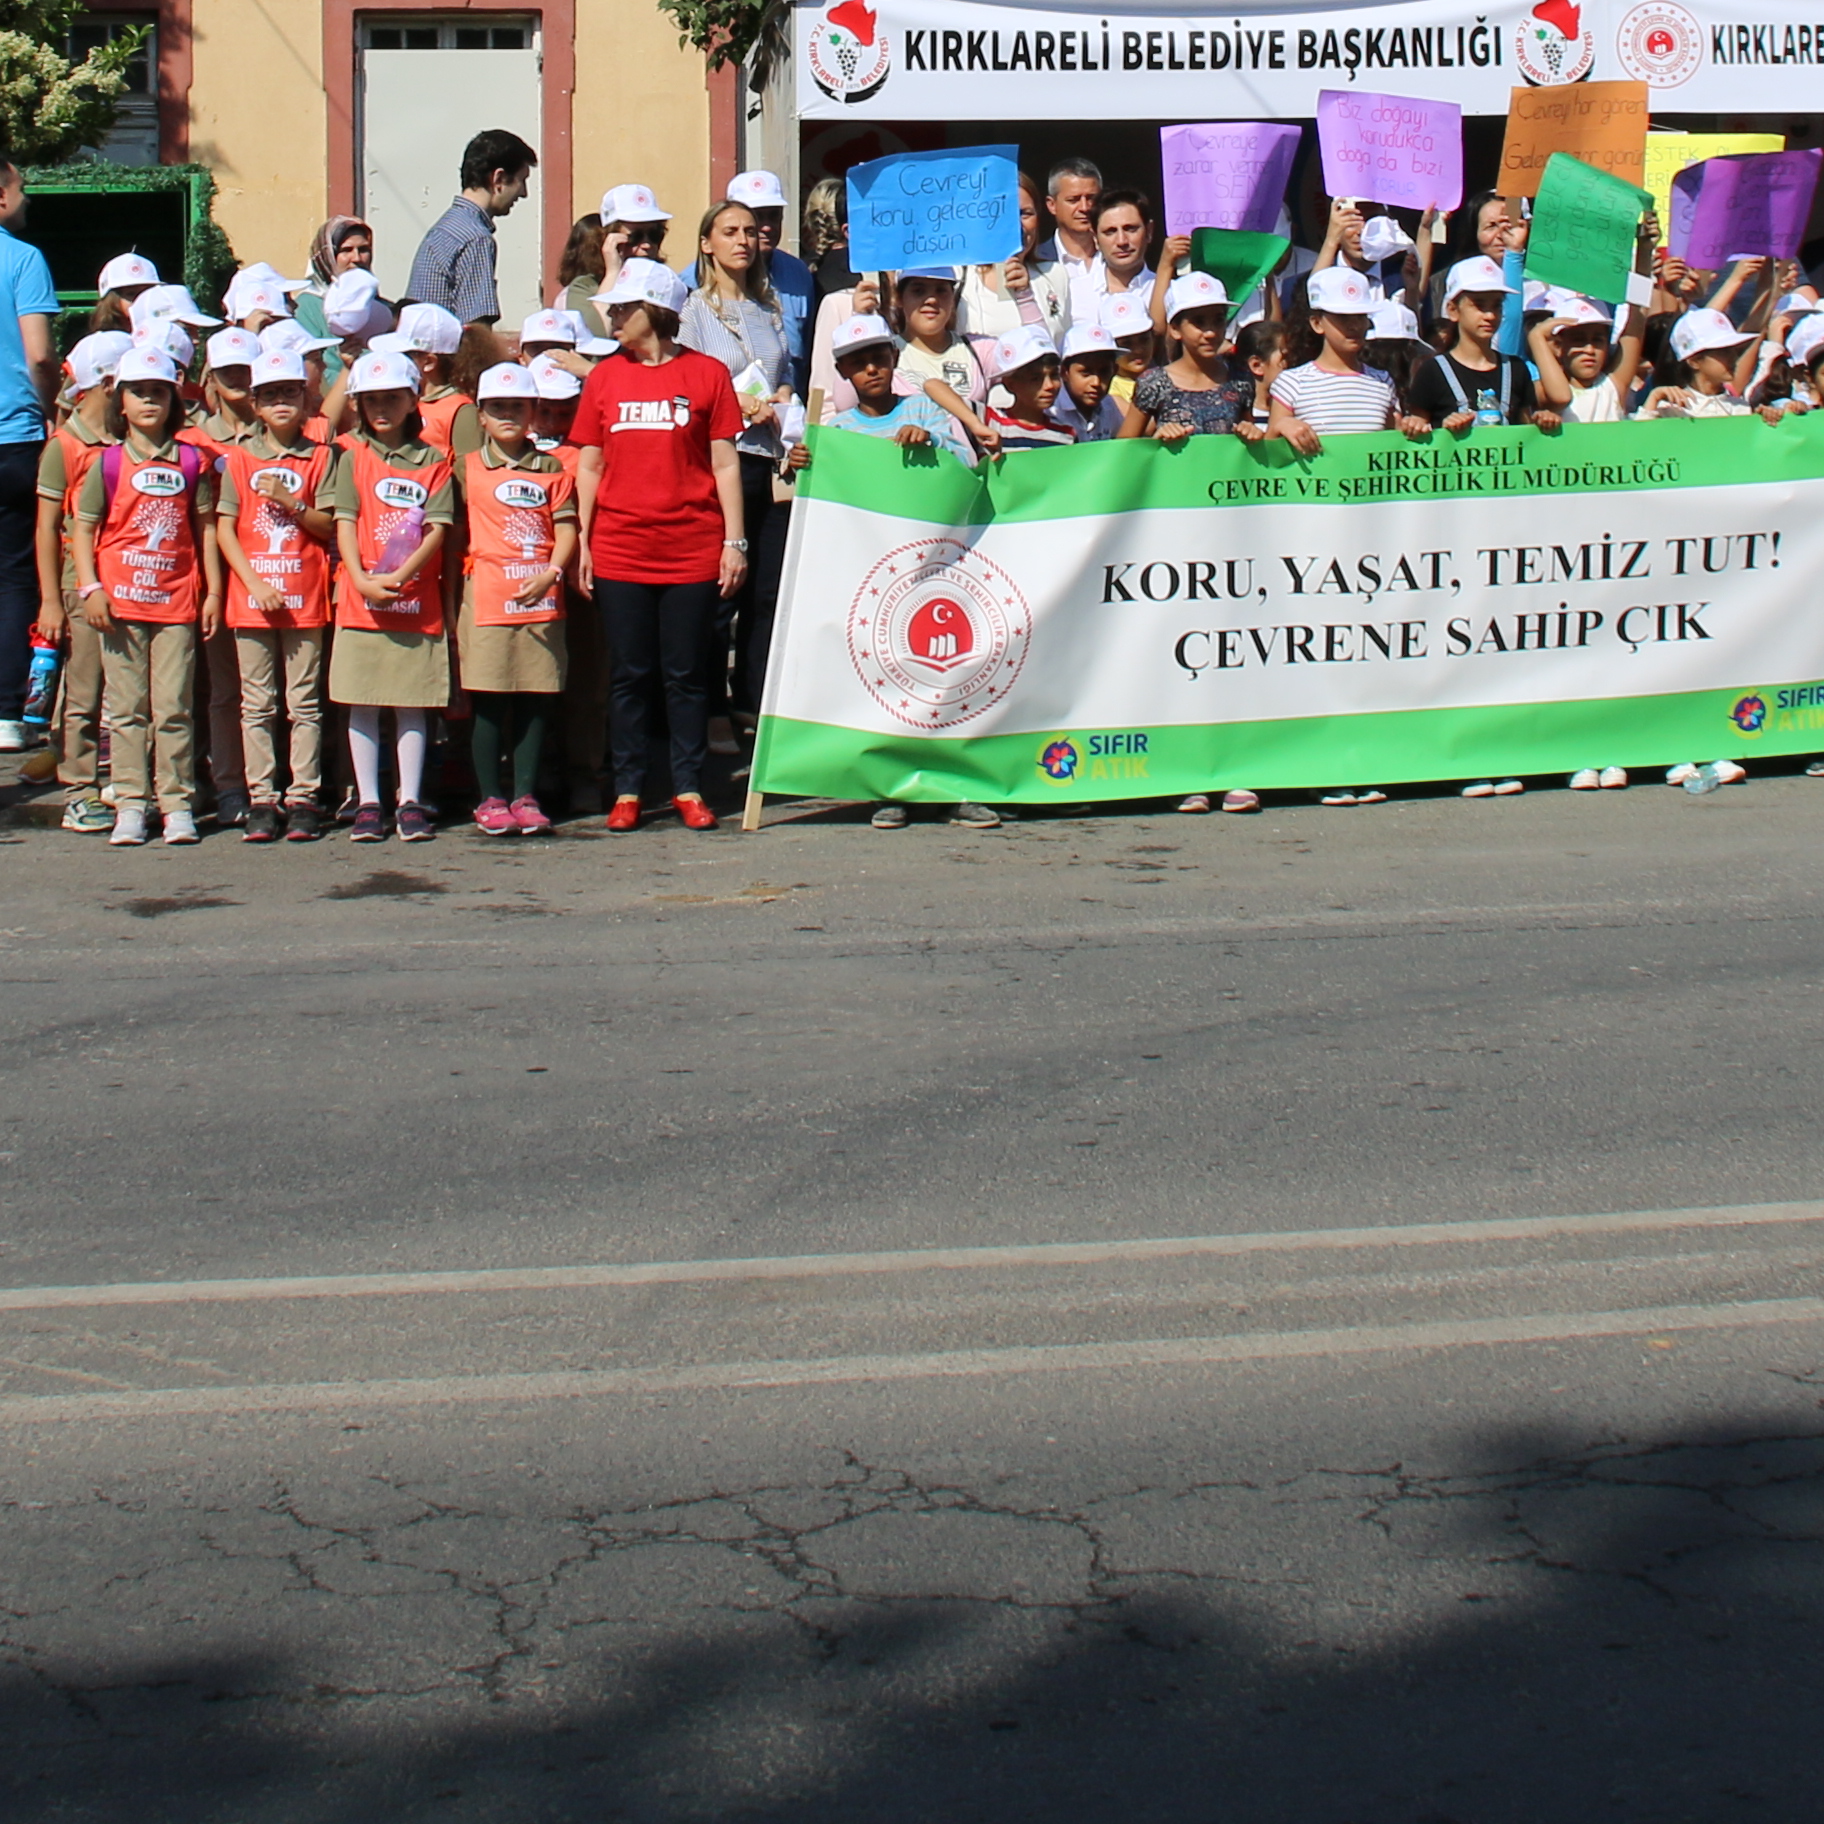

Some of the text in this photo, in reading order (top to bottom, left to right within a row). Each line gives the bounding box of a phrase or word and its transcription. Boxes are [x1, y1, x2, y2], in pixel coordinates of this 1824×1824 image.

[904, 15, 1502, 81] KIRKLARELİ BELEDİYE BAŞKANLIĞI
[1336, 92, 1428, 133] Biz doğayı
[1173, 160, 1218, 176] zarar
[1336, 140, 1444, 177] doğa da bizi
[898, 164, 989, 200] Çevreyi
[927, 194, 1007, 232] geleceği
[1174, 210, 1213, 226] zarar
[902, 230, 967, 255] düşün
[618, 399, 673, 422] TEMA
[1366, 441, 1525, 473] KIRKLARELİ
[144, 472, 173, 485] TEMA
[386, 482, 414, 498] TEMA
[1207, 457, 1683, 505] ÇEVRE VE ŞEHİRCİLİK İL MÜDÜRLÜĞÜ
[507, 484, 537, 499] TEMA
[121, 549, 176, 571] TÜRKİYE
[1098, 529, 1783, 606] KORU, YAŞAT, TEMİZ TUT!
[133, 569, 158, 588] ÇÖL
[949, 570, 963, 583] VE
[114, 584, 171, 604] OLMASIN
[963, 579, 1005, 638] ŞEHİRCİLİK
[1174, 601, 1715, 681] ÇEVRENE SAHİP ÇIK
[879, 647, 916, 691] TÜRKİYE
[959, 641, 1004, 695] BAKANLIĞI
[1088, 733, 1149, 756] SIFIR
[1090, 756, 1150, 781] ATIK
